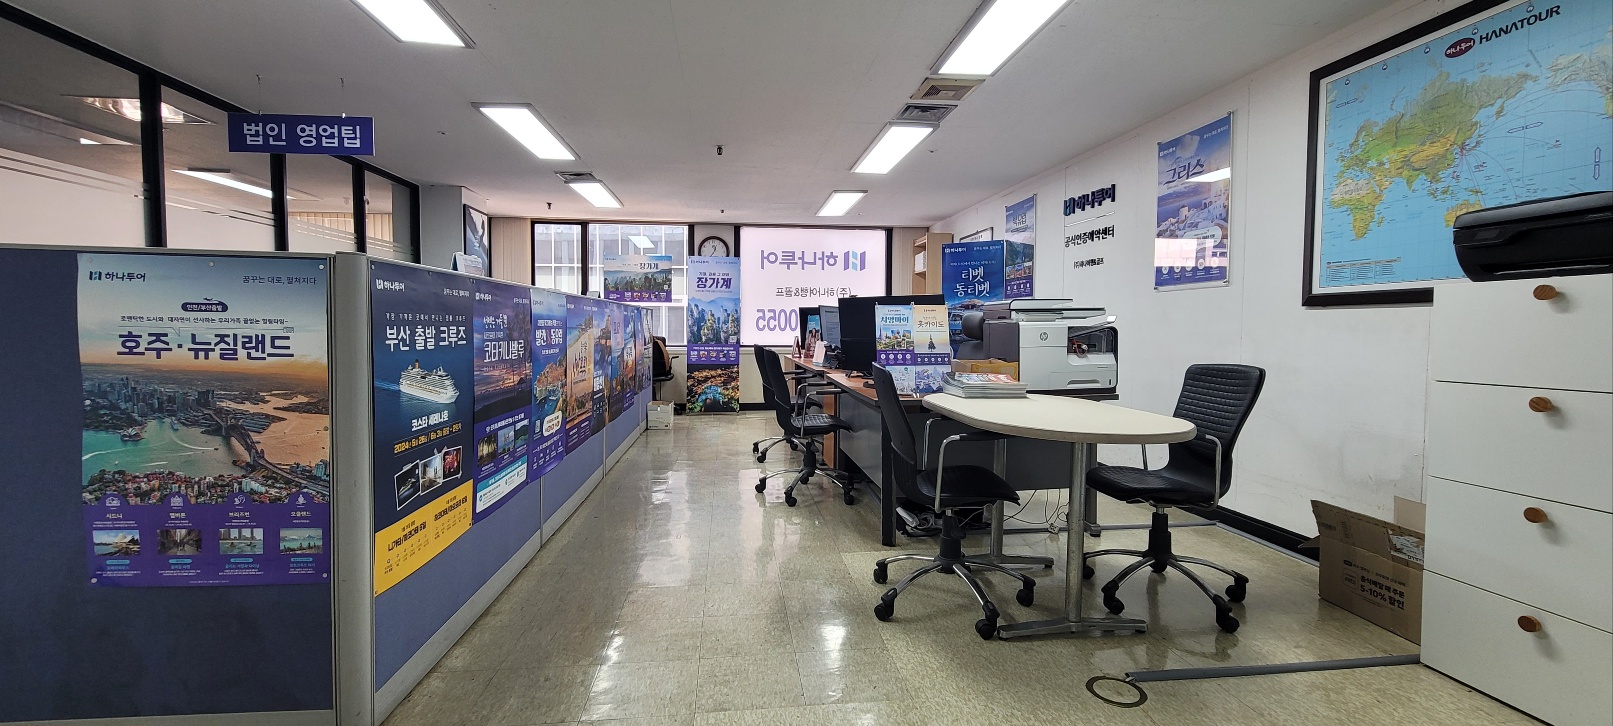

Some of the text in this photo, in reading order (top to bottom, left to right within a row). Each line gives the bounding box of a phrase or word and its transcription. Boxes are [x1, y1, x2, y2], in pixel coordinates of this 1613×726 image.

[1479, 5, 1560, 44] HANATOUR
[243, 122, 287, 146] 법인
[1163, 158, 1205, 186] 그리스
[1075, 183, 1116, 212] 하나투어
[1064, 224, 1115, 248] 공식인증예약센터
[639, 262, 659, 271] 장가계
[961, 265, 984, 282] 티벳
[104, 271, 147, 283] 하나투어
[242, 275, 317, 286] 꿈꾸는 대로, 펼쳐지다
[696, 276, 733, 290] 장가계
[383, 281, 405, 292] 하나투어
[953, 281, 990, 298] 동티벳
[385, 324, 467, 352] 부산 출발 크루즈
[483, 339, 525, 363] 코타키나발루
[411, 415, 428, 432] 코스타
[1360, 584, 1387, 602] 5-10%
